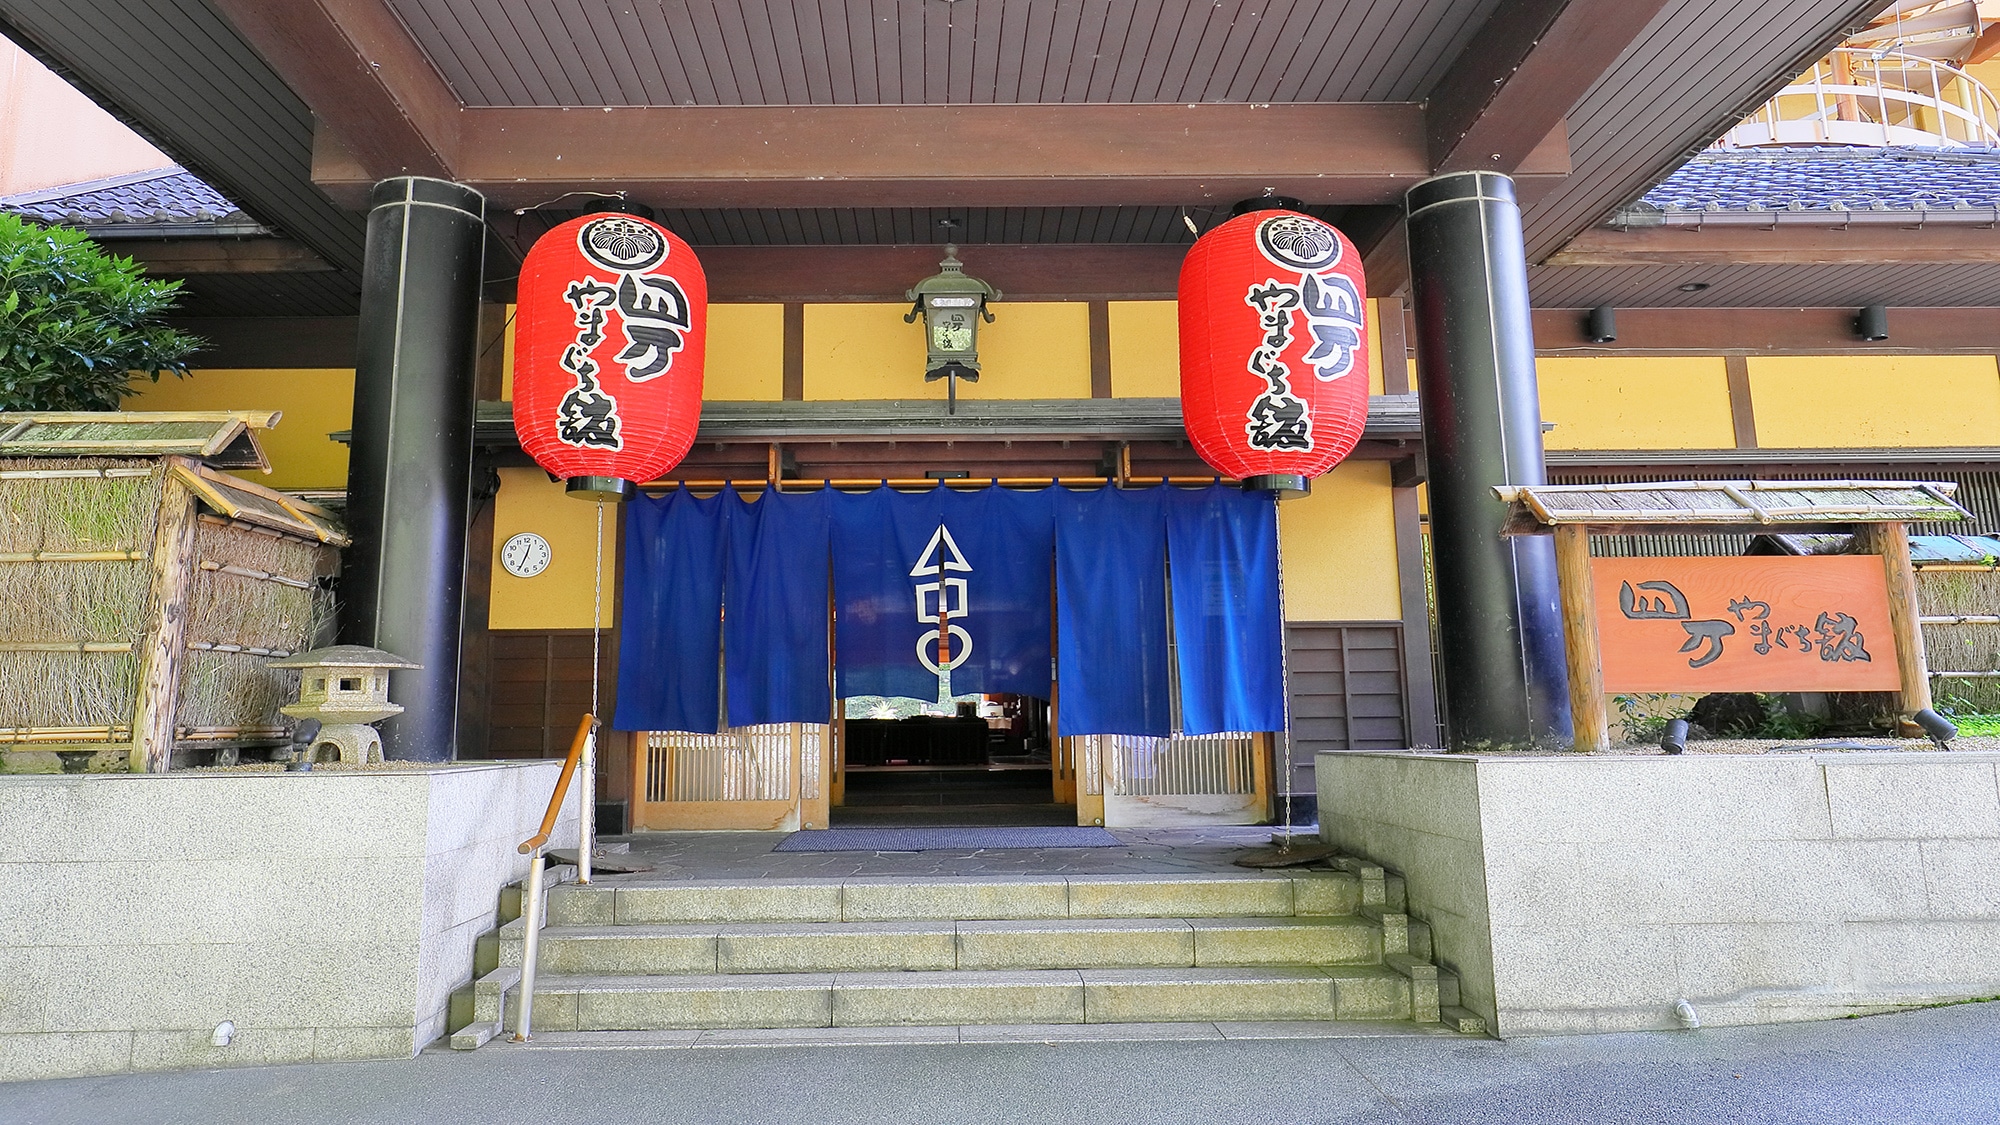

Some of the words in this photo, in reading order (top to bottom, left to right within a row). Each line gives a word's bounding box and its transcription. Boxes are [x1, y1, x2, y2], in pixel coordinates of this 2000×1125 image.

[618, 273, 690, 378] 四万
[1302, 273, 1362, 378] 四万
[1618, 579, 1735, 669] 四万
